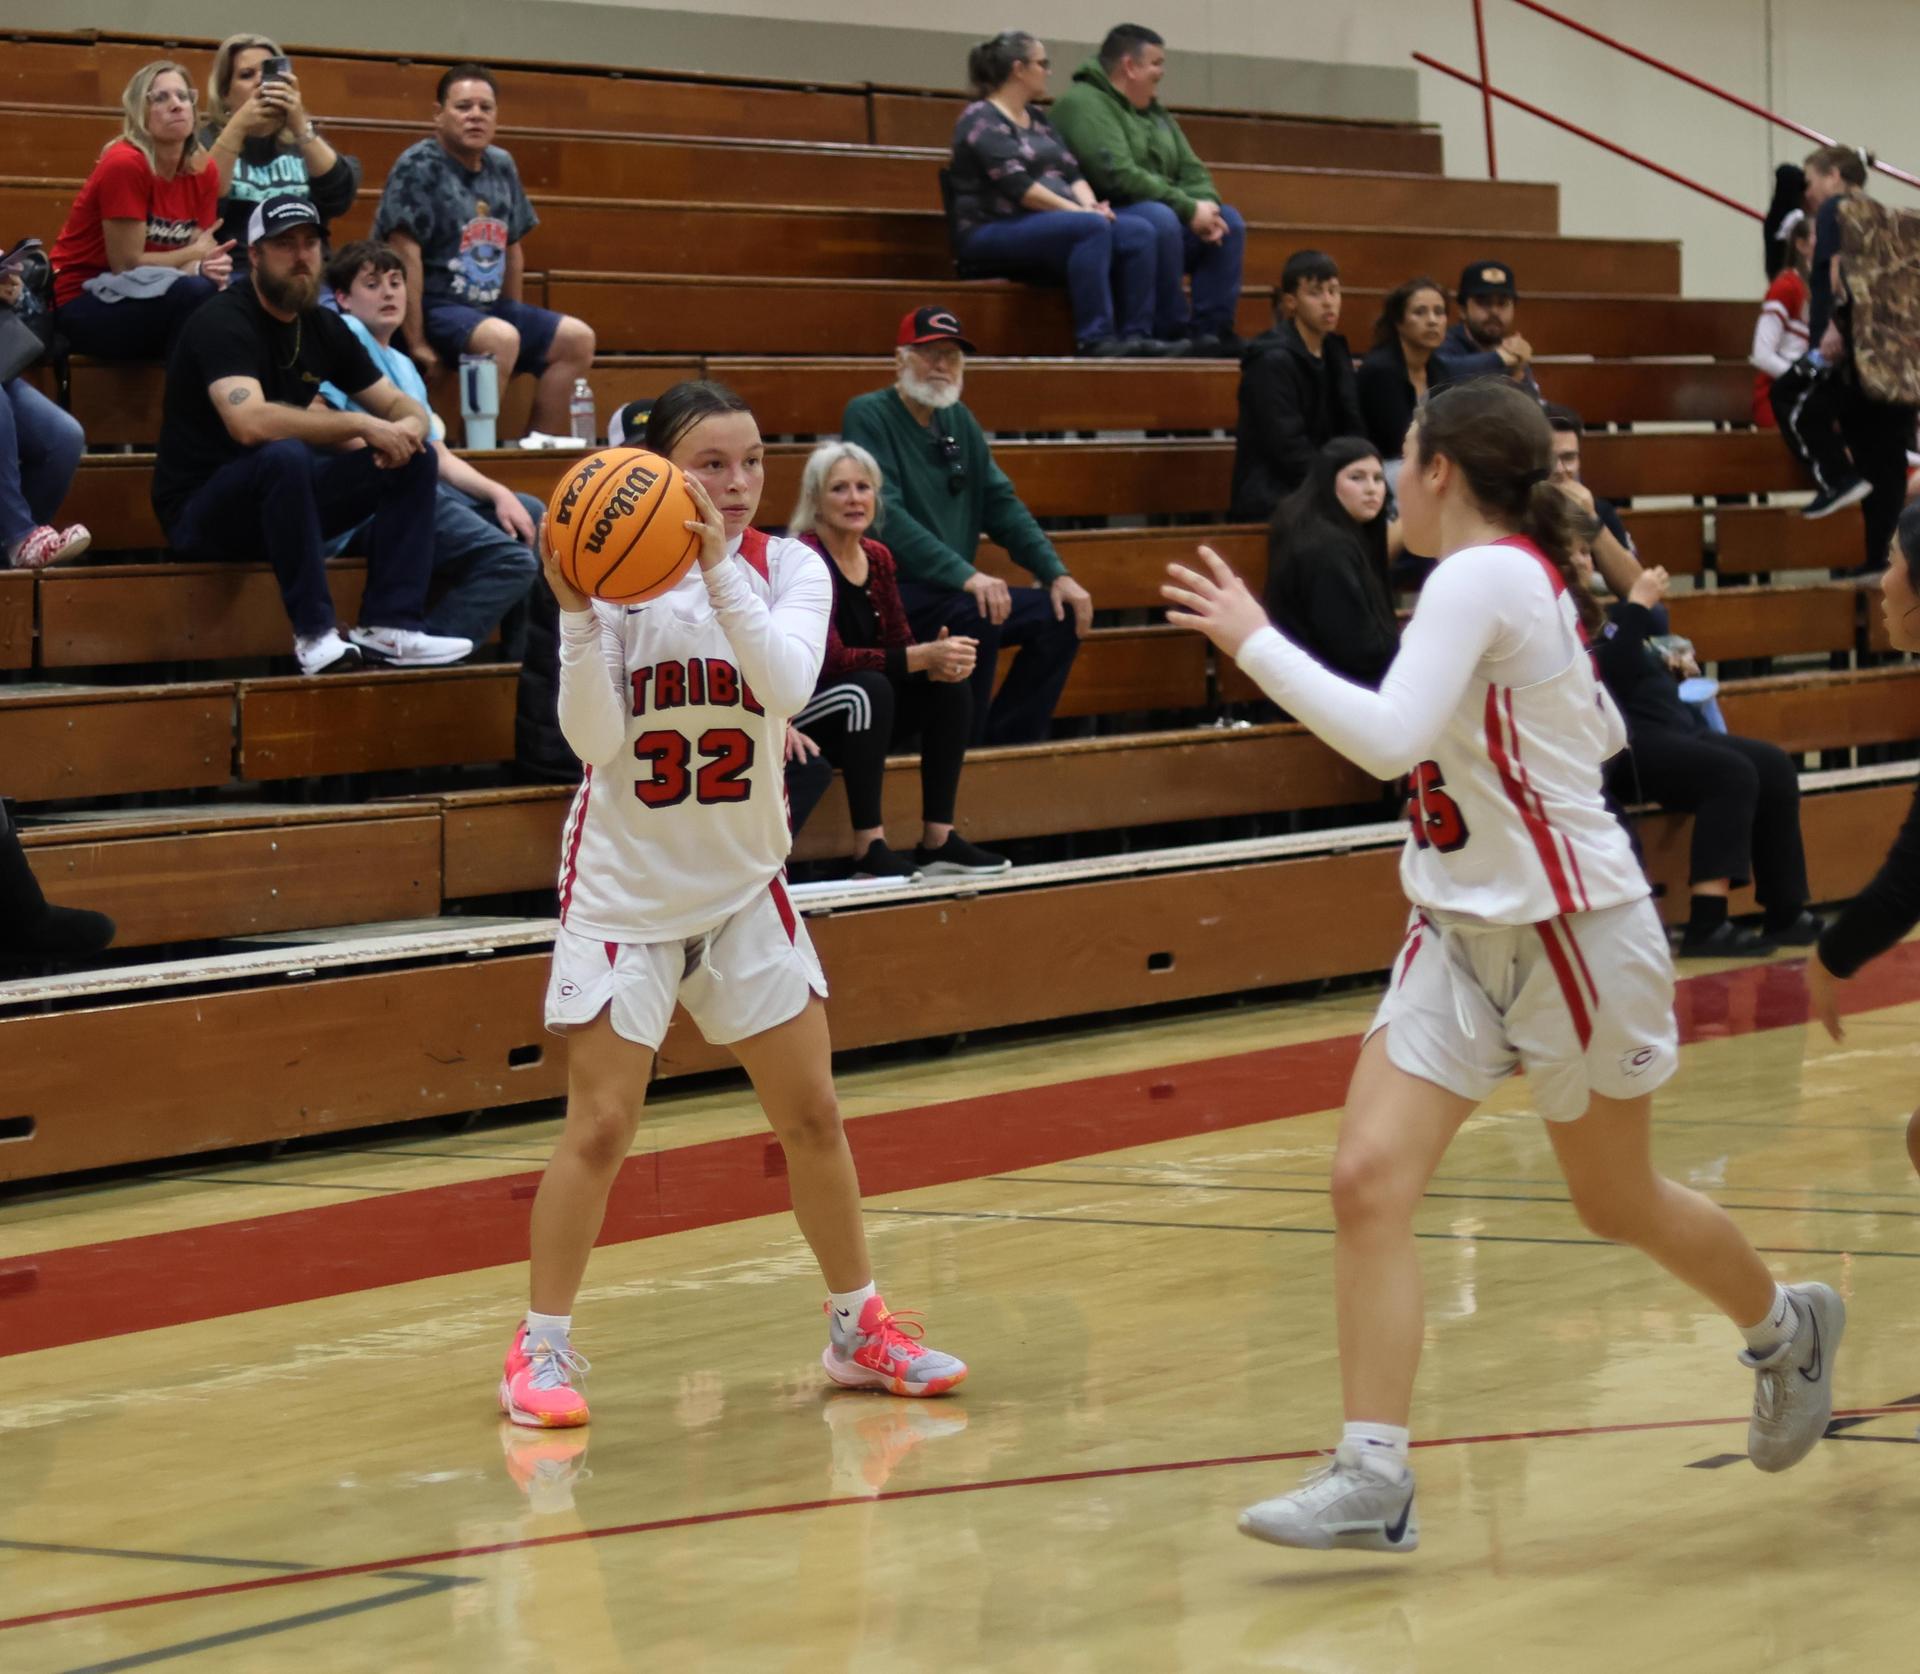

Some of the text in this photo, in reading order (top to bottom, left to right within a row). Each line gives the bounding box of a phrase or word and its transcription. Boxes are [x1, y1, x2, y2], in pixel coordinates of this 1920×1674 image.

[556, 458, 606, 525] NCAA
[584, 466, 659, 554] Wilson
[634, 728, 755, 809] 32
